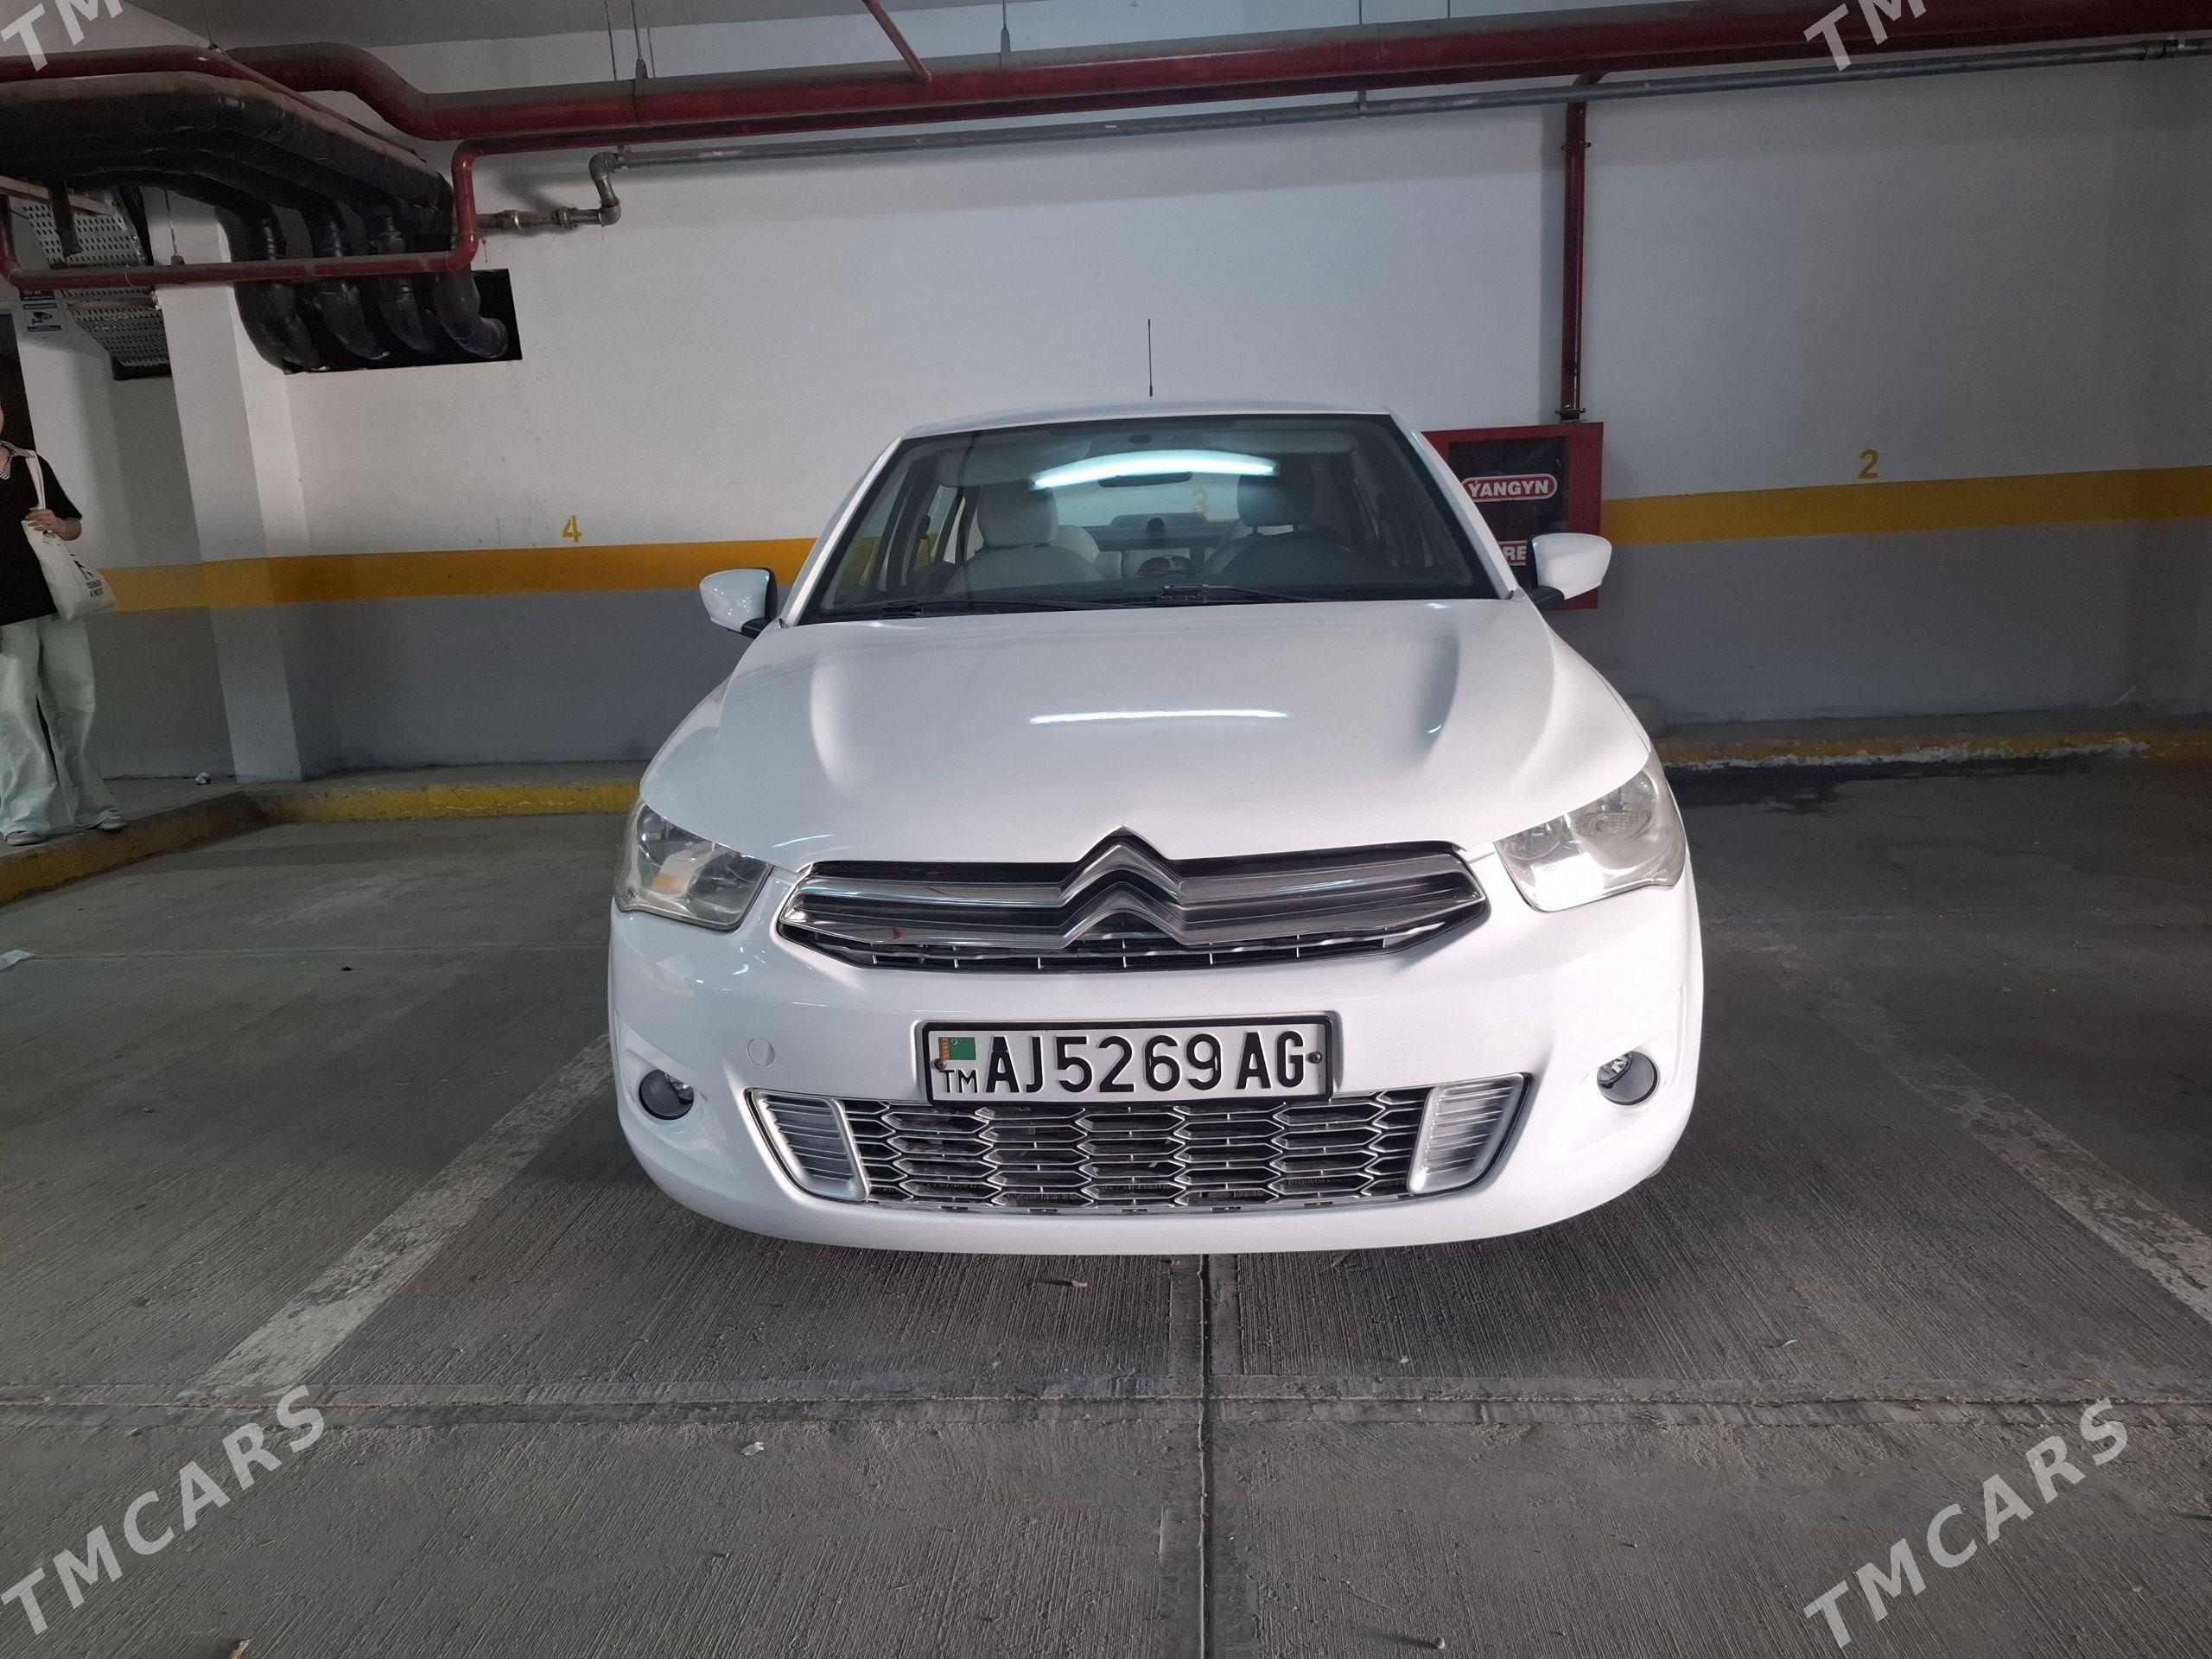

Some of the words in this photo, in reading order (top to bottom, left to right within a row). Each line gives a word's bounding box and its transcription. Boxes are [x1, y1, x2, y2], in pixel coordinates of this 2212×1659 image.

[1858, 448, 1879, 480] 2
[562, 514, 582, 543] 4
[1502, 545, 1527, 561] RE
[940, 1070, 977, 1093] TM
